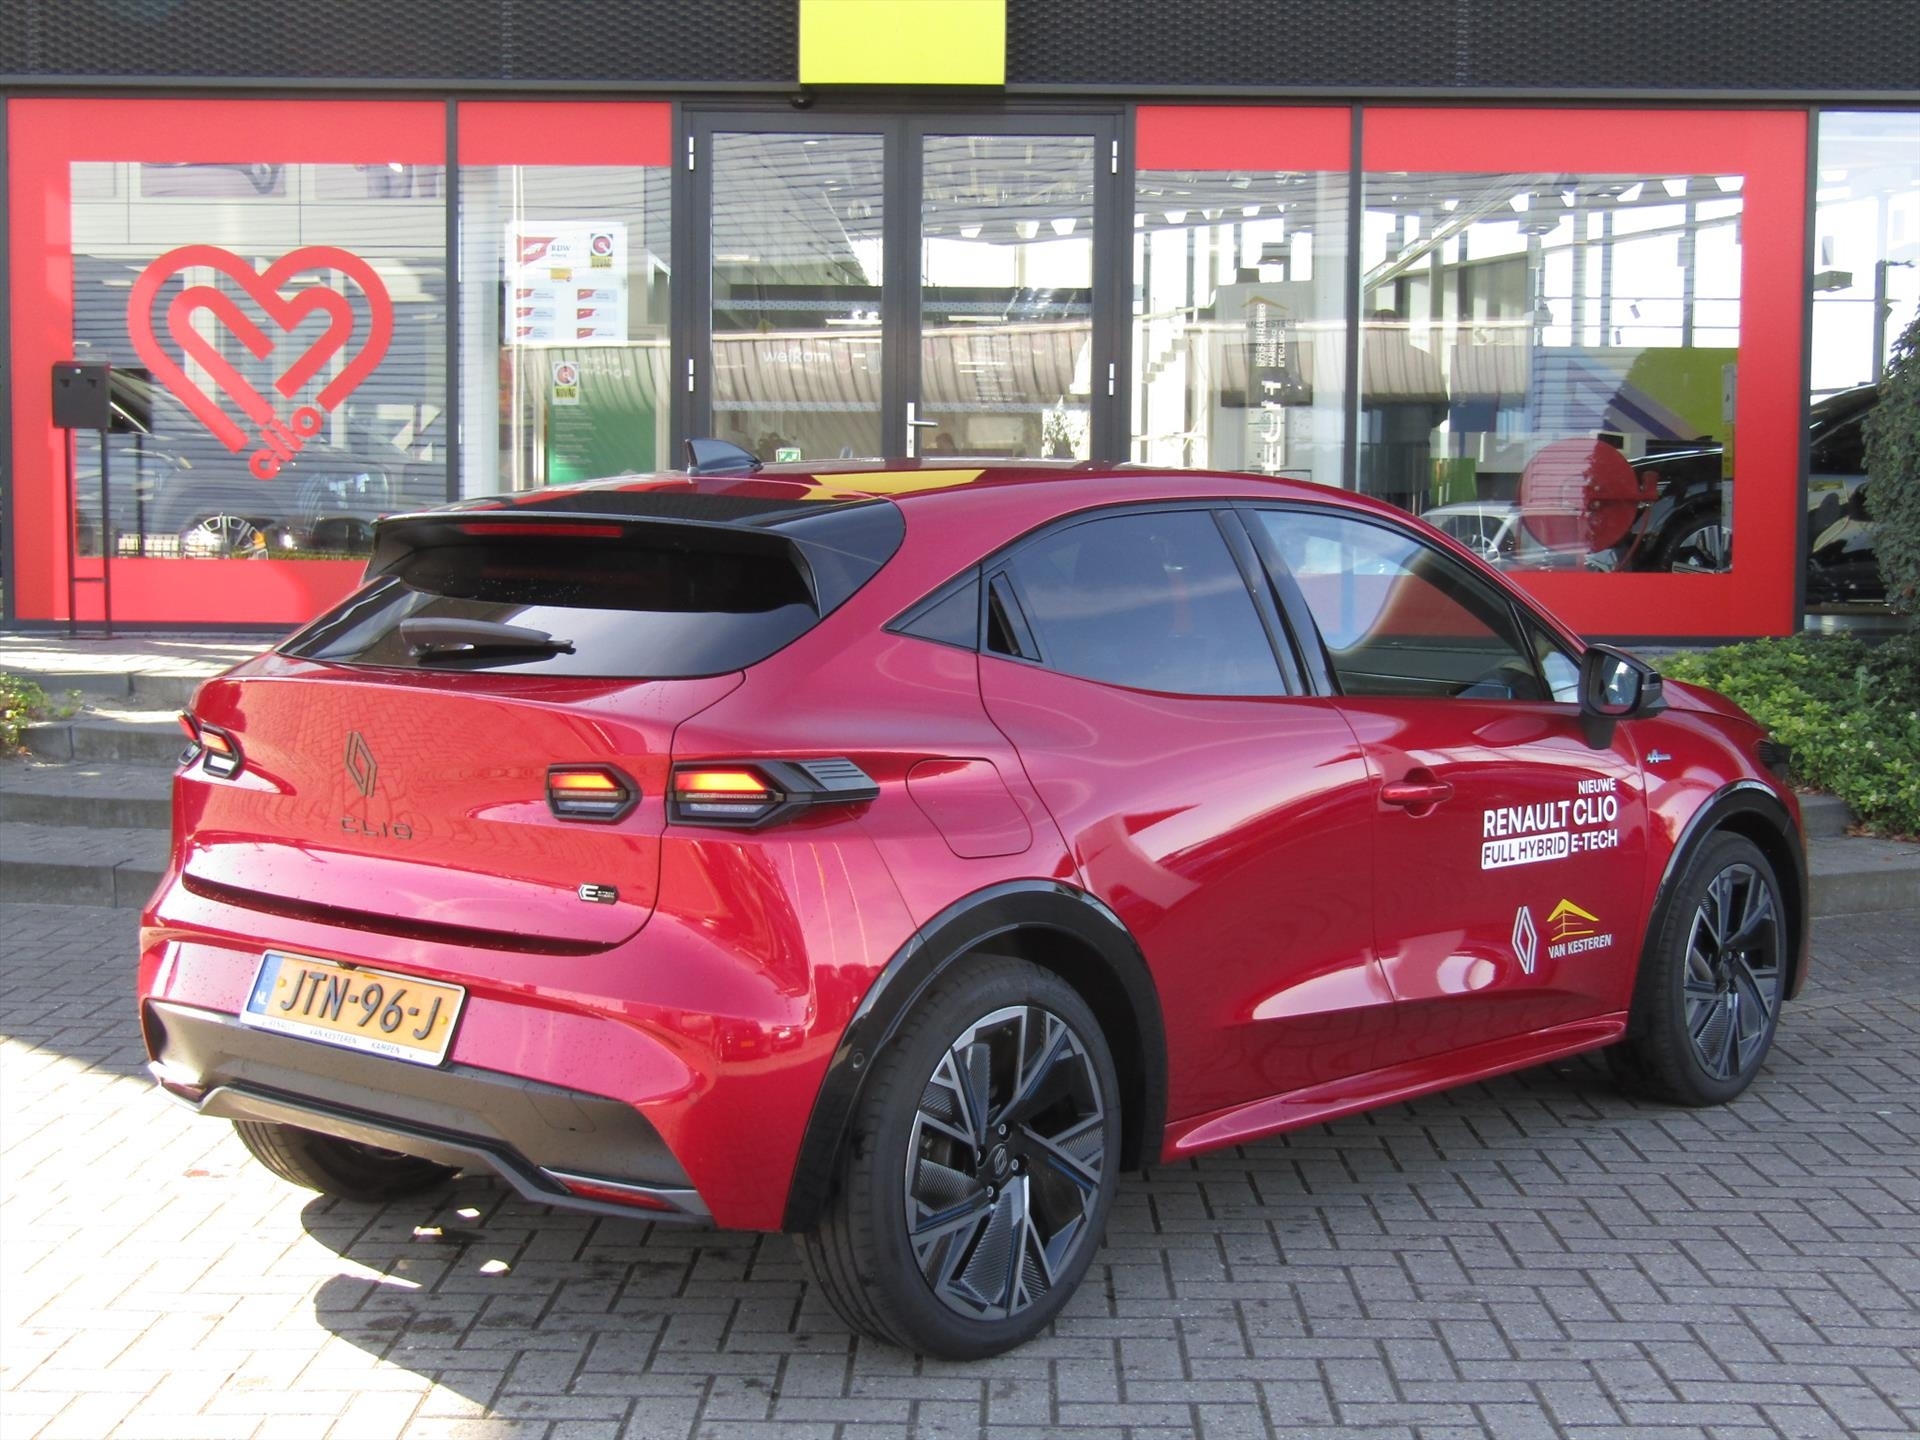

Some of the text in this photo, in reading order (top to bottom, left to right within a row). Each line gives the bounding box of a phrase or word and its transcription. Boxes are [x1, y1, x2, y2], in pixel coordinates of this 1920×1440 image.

[763, 347, 830, 362] welkom
[1578, 778, 1616, 794] NIEUWE
[341, 816, 413, 840] CLIO
[1483, 795, 1617, 838] RENAULT CLIO
[1483, 829, 1618, 865] FULL HYBRID E-TECH
[1548, 934, 1612, 959] VAN KESTEREN
[253, 990, 267, 1005] NL
[279, 969, 442, 1040] JTN-96-J
[324, 1031, 357, 1045] KESTEREN
[371, 1042, 400, 1055] KAMPEN
